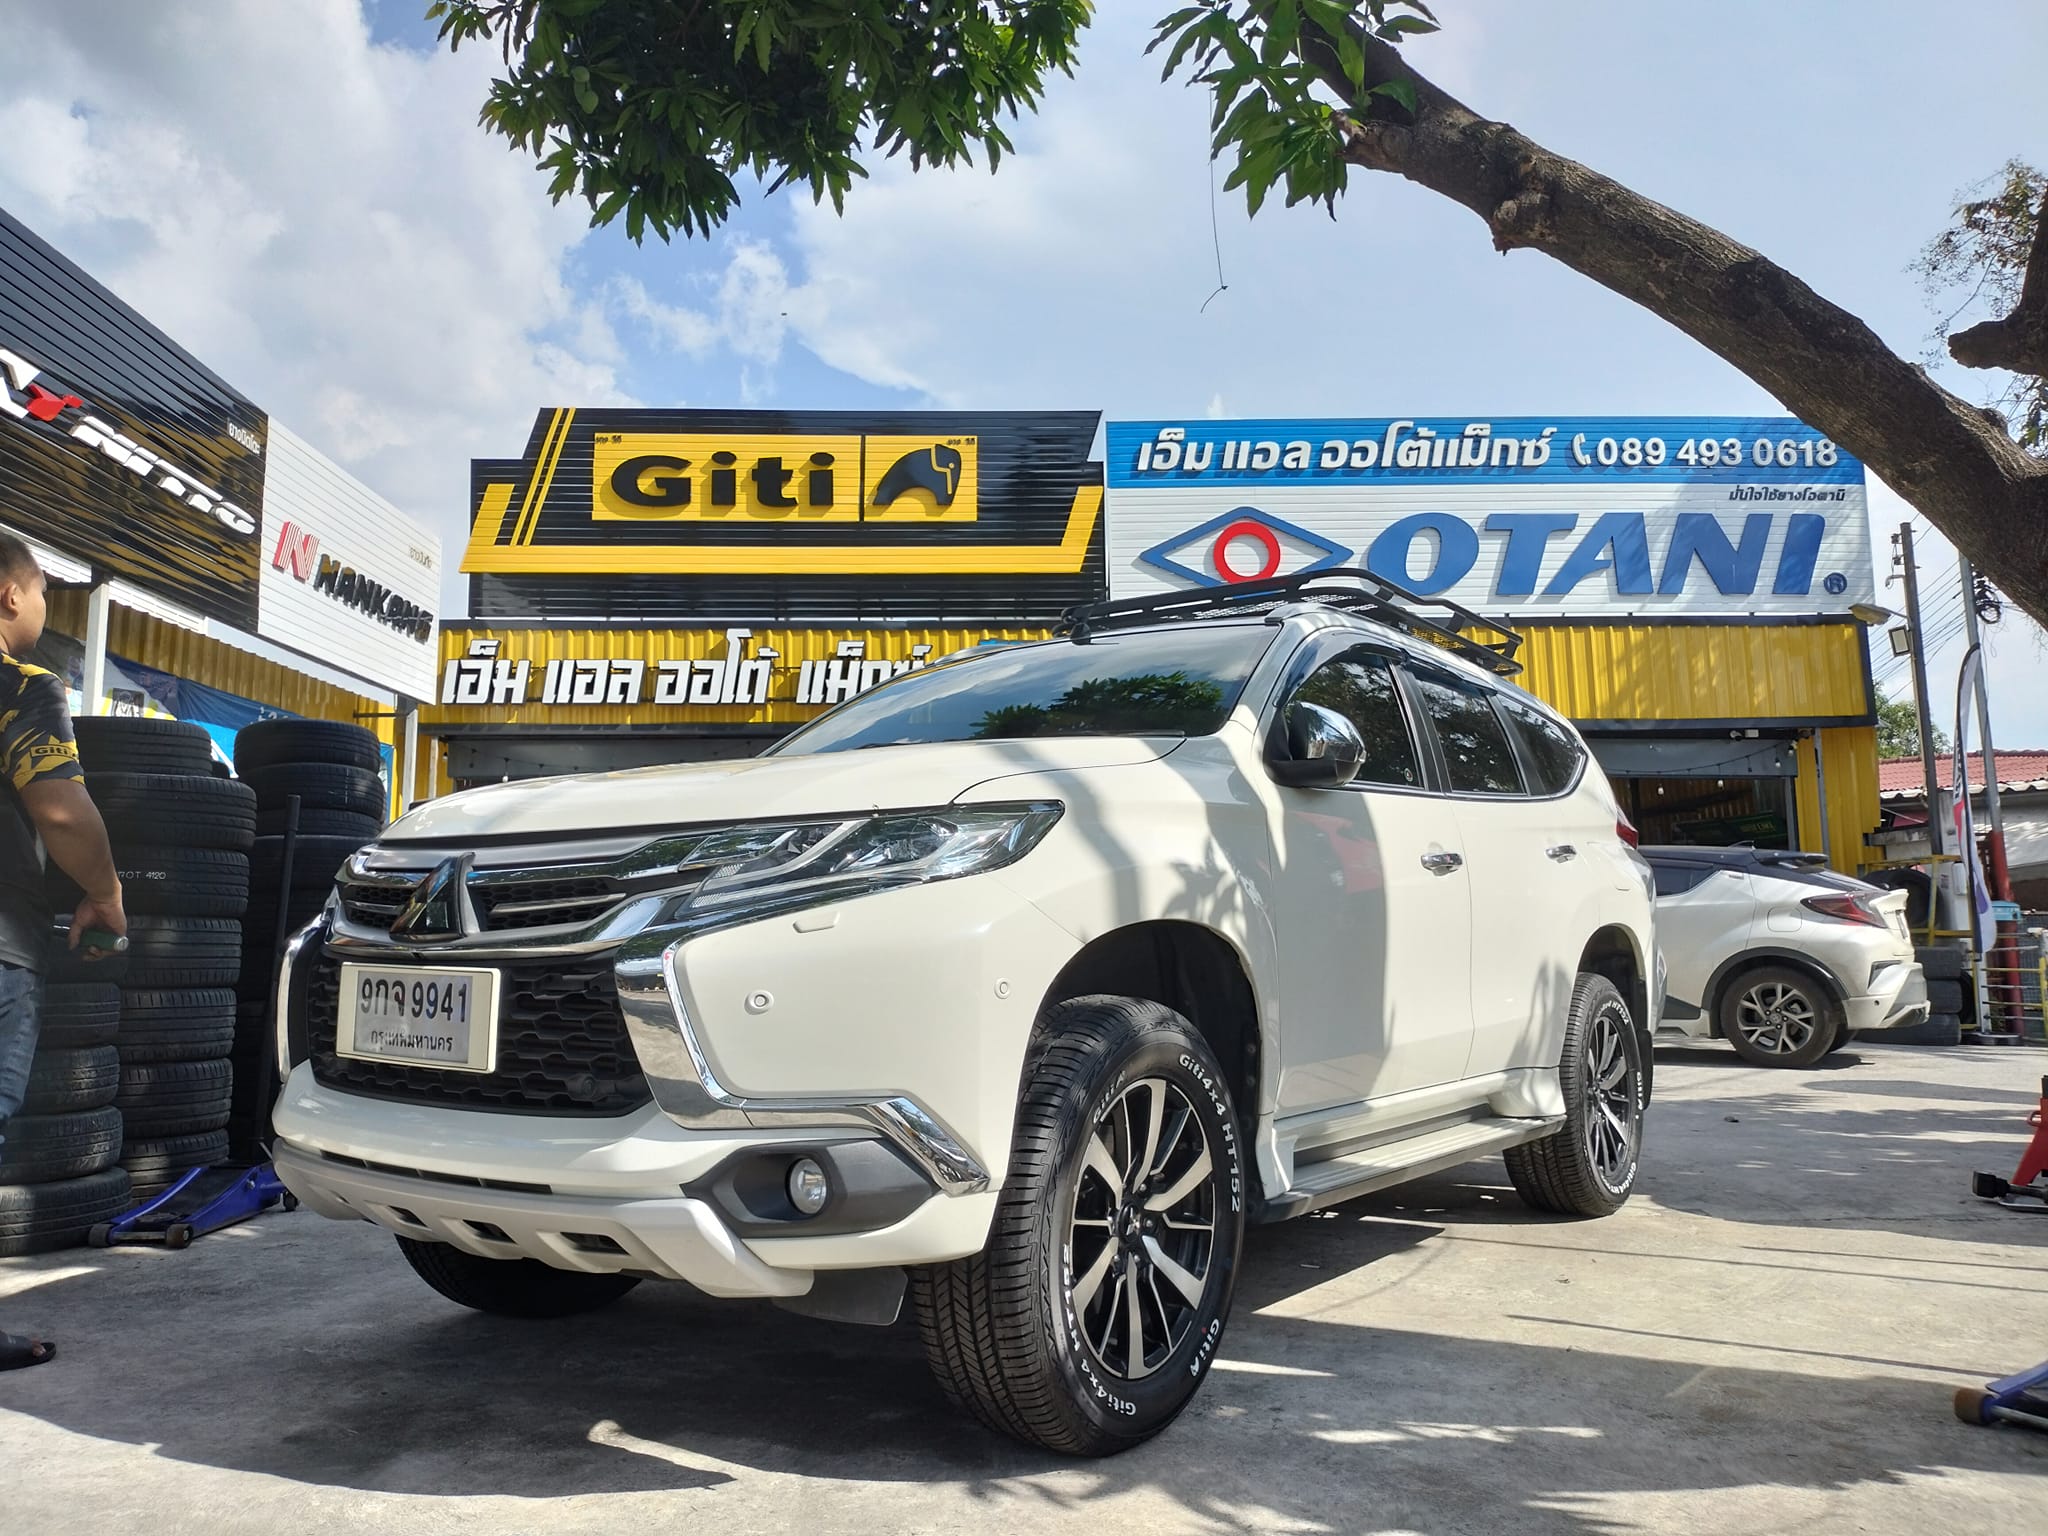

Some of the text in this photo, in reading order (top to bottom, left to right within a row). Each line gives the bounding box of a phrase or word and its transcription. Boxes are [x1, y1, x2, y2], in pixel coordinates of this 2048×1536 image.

[611, 450, 835, 508] Giti
[1136, 428, 1214, 472] เอ็ม
[1221, 439, 1312, 471] แอล
[1596, 437, 1839, 468] 089 493 0618
[1366, 512, 1827, 596] OTANI
[313, 553, 434, 645] NANKANG
[441, 639, 532, 705] เอ็ม
[542, 659, 645, 705] แอล
[654, 628, 781, 705] ออโต้
[360, 978, 467, 1023] 9กจ 9941
[1222, 1122, 1241, 1213] HT152
